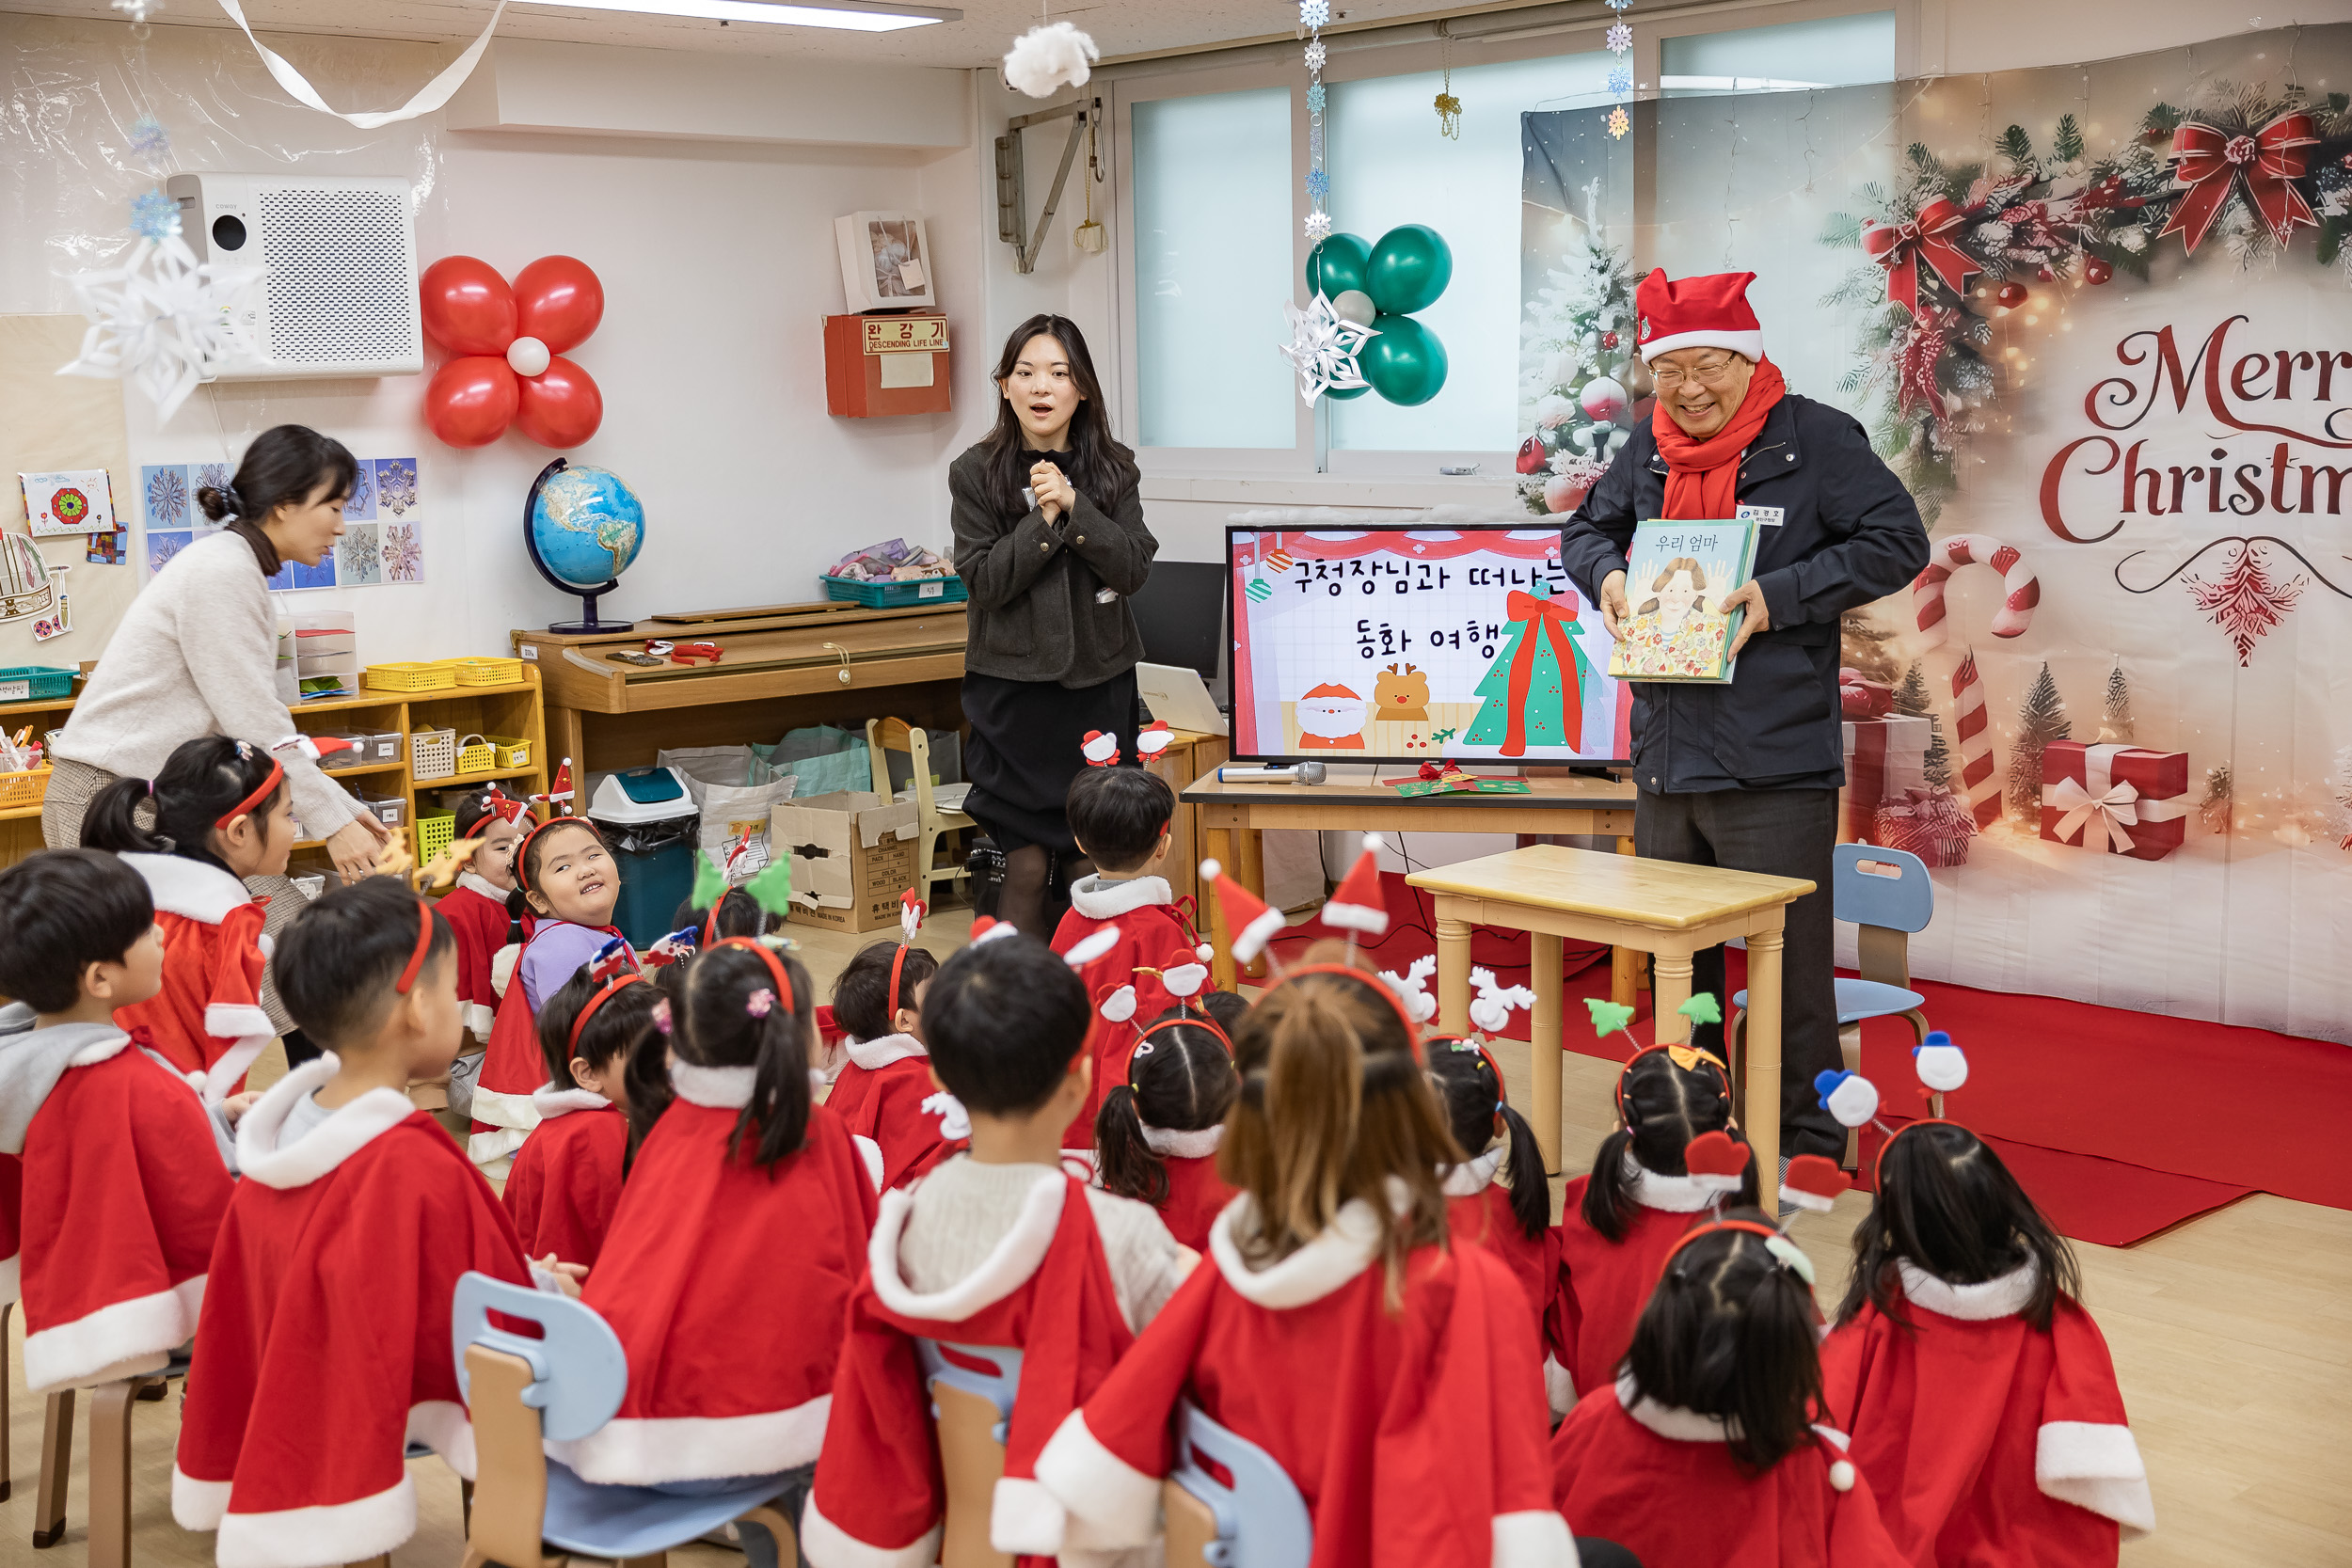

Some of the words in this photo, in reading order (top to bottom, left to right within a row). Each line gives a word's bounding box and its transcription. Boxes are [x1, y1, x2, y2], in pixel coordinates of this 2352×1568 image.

[868, 340, 911, 349] DESCENDING
[2085, 315, 2352, 449] Merr
[1656, 534, 1684, 553] 우리
[1690, 534, 1718, 553] 엄마
[1295, 559, 1451, 596] 구청장님과
[1469, 559, 1565, 594] 떠나는
[1357, 619, 1412, 658] 동화
[1430, 620, 1499, 658] 여행
[878, 845, 898, 853] CHANNEL
